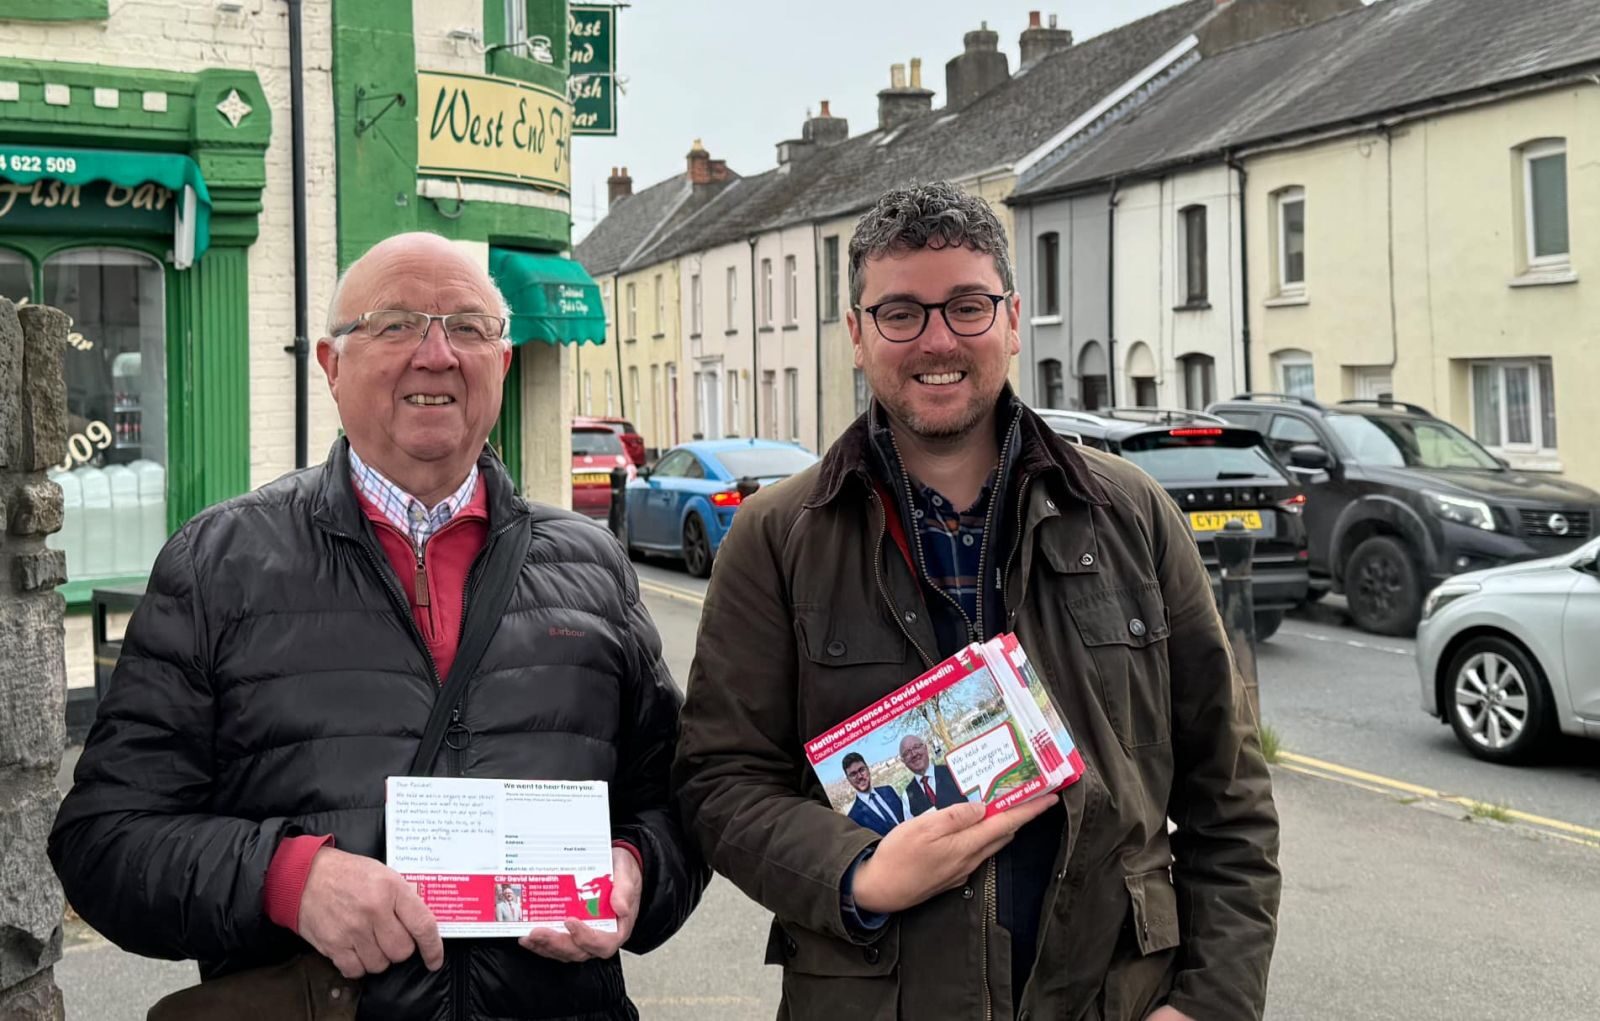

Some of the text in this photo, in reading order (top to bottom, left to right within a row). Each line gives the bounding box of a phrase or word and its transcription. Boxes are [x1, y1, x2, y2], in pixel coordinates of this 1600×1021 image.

[430, 86, 504, 148] West
[513, 97, 546, 154] End
[569, 108, 597, 127] ar
[10, 155, 42, 172] 622
[46, 157, 77, 173] 509
[549, 626, 585, 637] Barbour
[809, 664, 955, 753] Matthew Dorrance & David Meredith
[813, 695, 922, 761] County Councillors for Brecon West Ward
[952, 755, 963, 765] We
[964, 746, 979, 758] held
[978, 747, 1003, 764] surgery
[995, 780, 1041, 810] on your side
